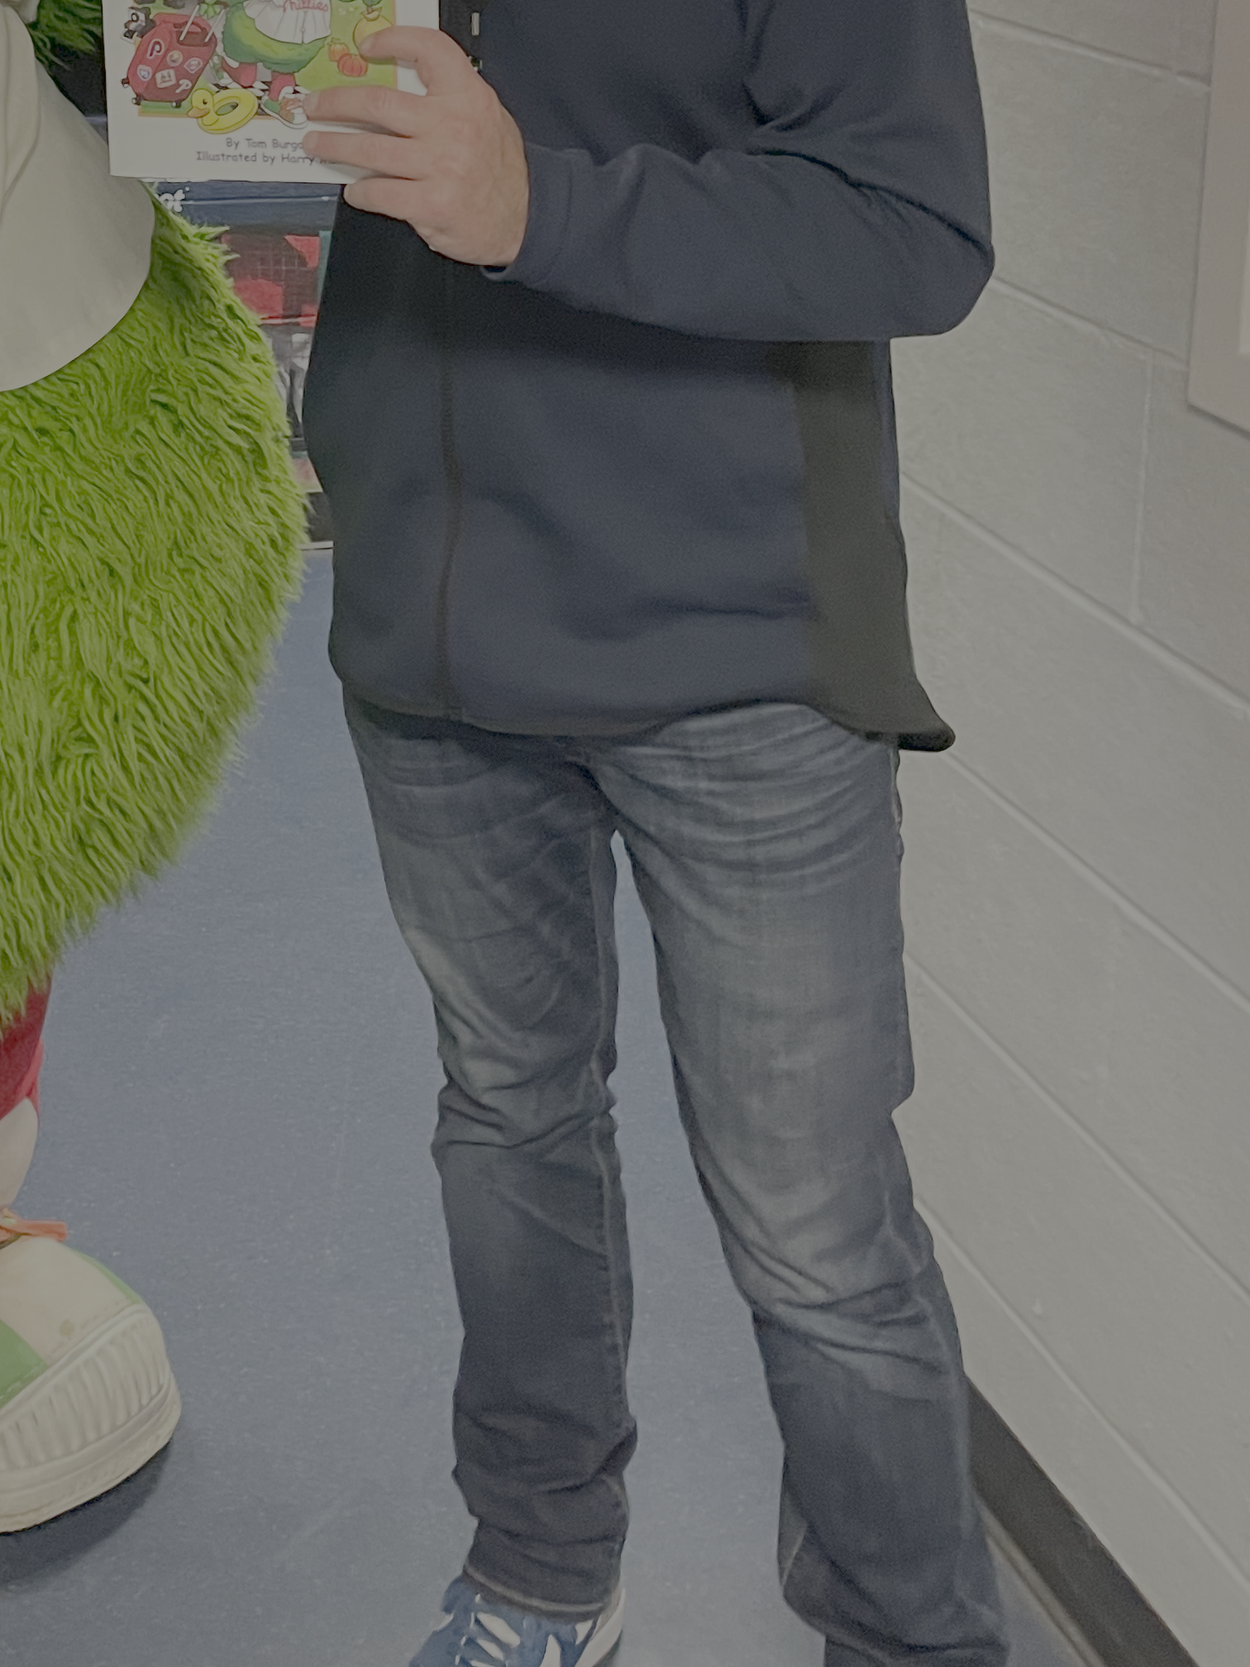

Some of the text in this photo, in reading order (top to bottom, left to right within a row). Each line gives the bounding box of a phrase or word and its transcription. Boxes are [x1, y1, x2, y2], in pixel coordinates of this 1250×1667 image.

[225, 137, 304, 152] By Tom Burgo
[196, 151, 257, 163] Illustrated
[262, 151, 276, 166] by
[281, 152, 316, 166] Harry
